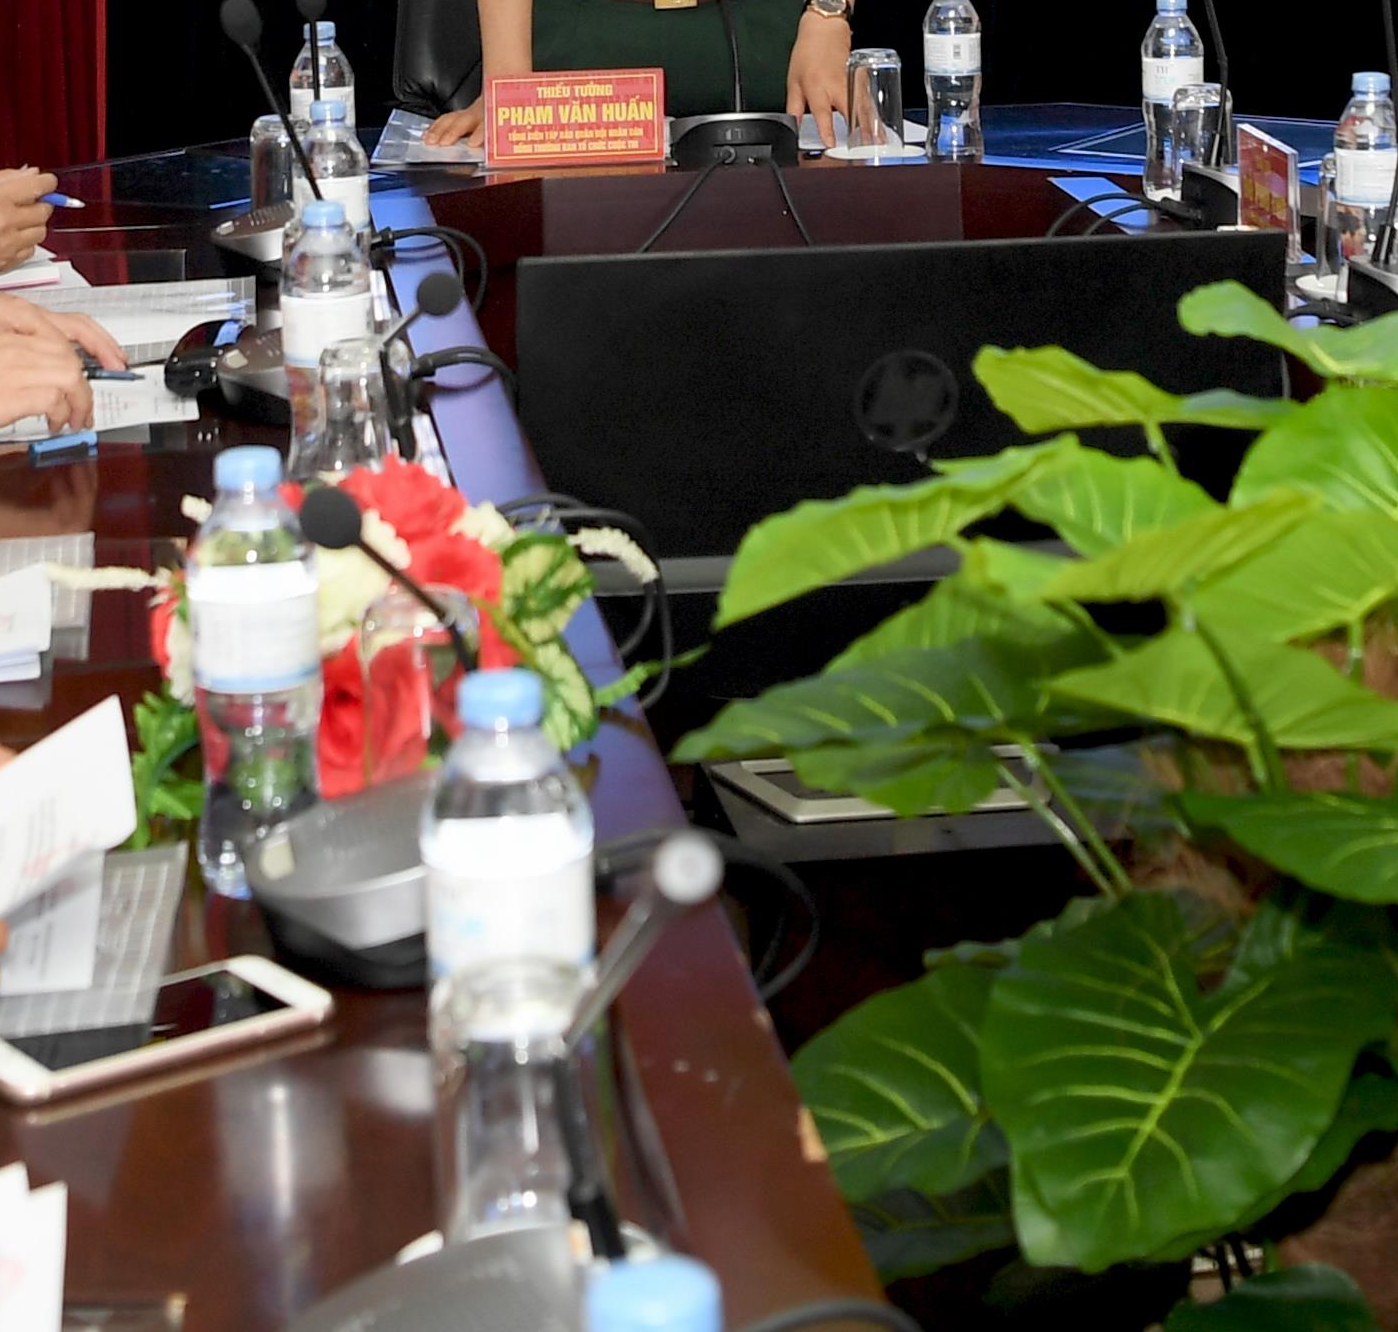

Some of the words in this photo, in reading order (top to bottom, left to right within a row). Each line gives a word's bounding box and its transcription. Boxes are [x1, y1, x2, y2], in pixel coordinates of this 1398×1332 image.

[498, 105, 552, 129] PHẠM
[559, 101, 596, 123] VĂN
[602, 95, 653, 122] HUẤN
